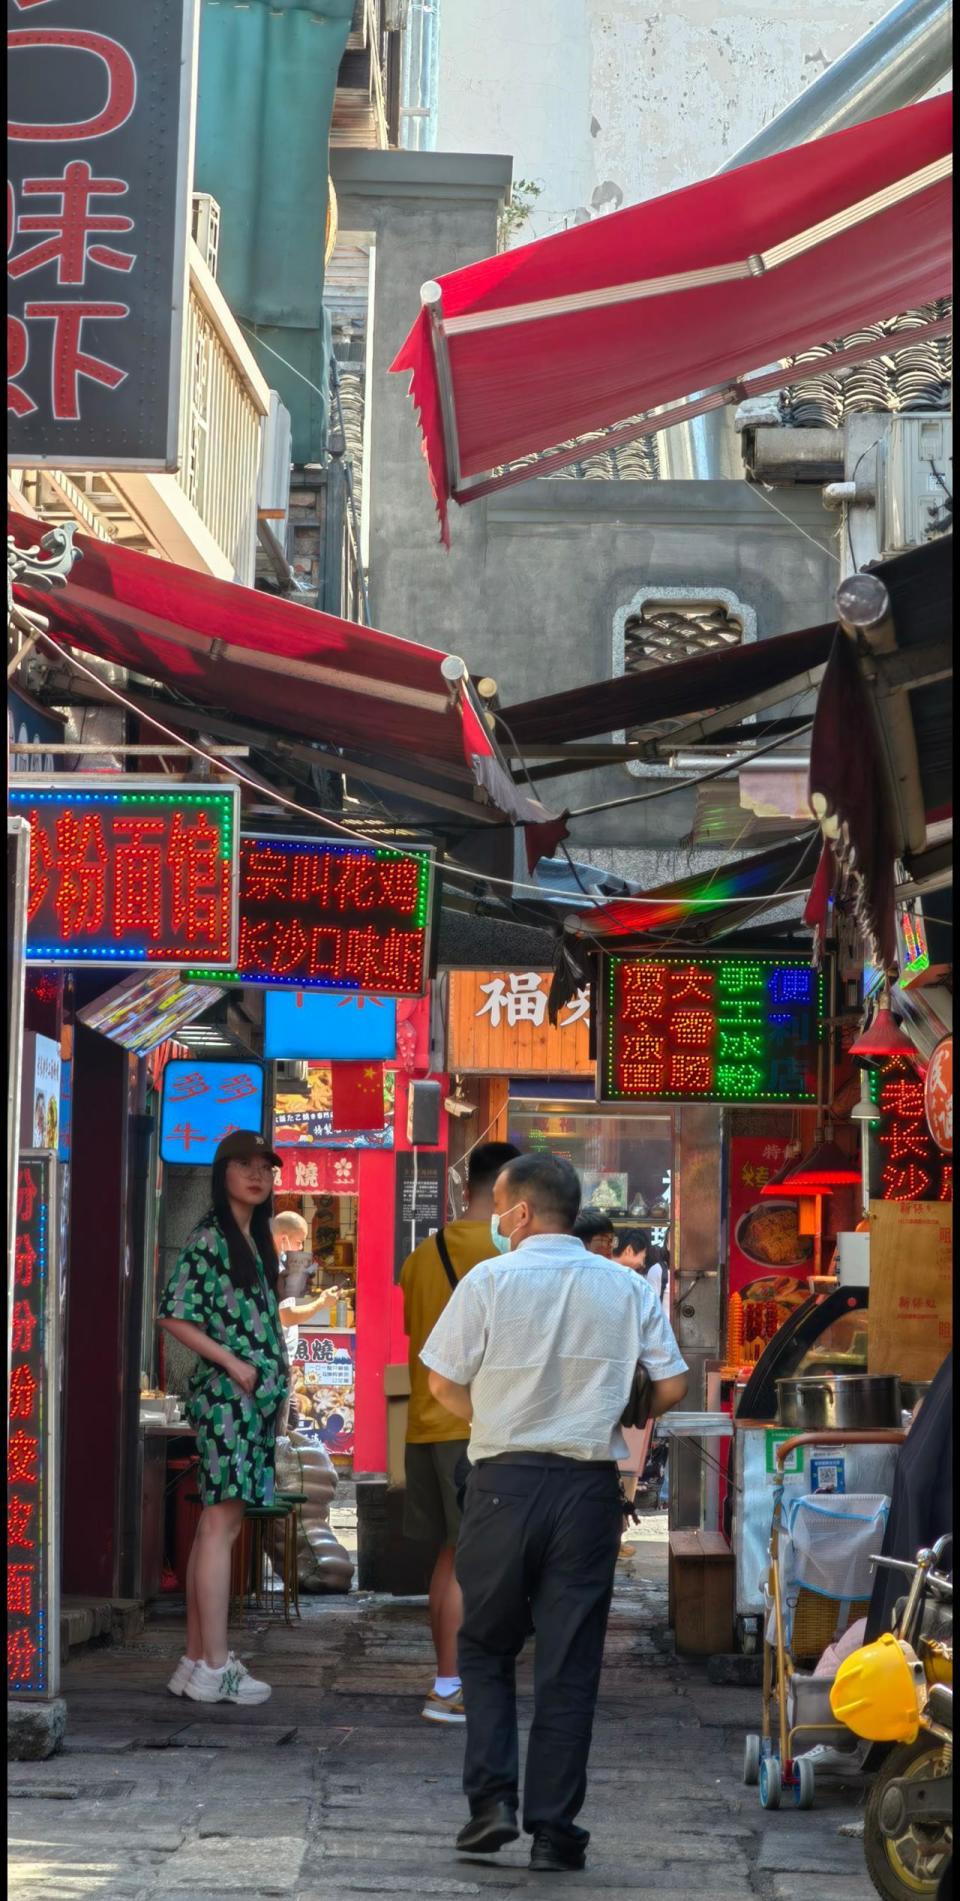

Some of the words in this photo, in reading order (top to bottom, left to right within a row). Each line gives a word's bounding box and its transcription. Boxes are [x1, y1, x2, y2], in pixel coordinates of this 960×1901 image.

[8, 0, 137, 420] 口味虾
[238, 847, 419, 913] 宗叫花鸡
[717, 966, 762, 1092] 手工冰粉
[168, 1071, 258, 1104] 多多
